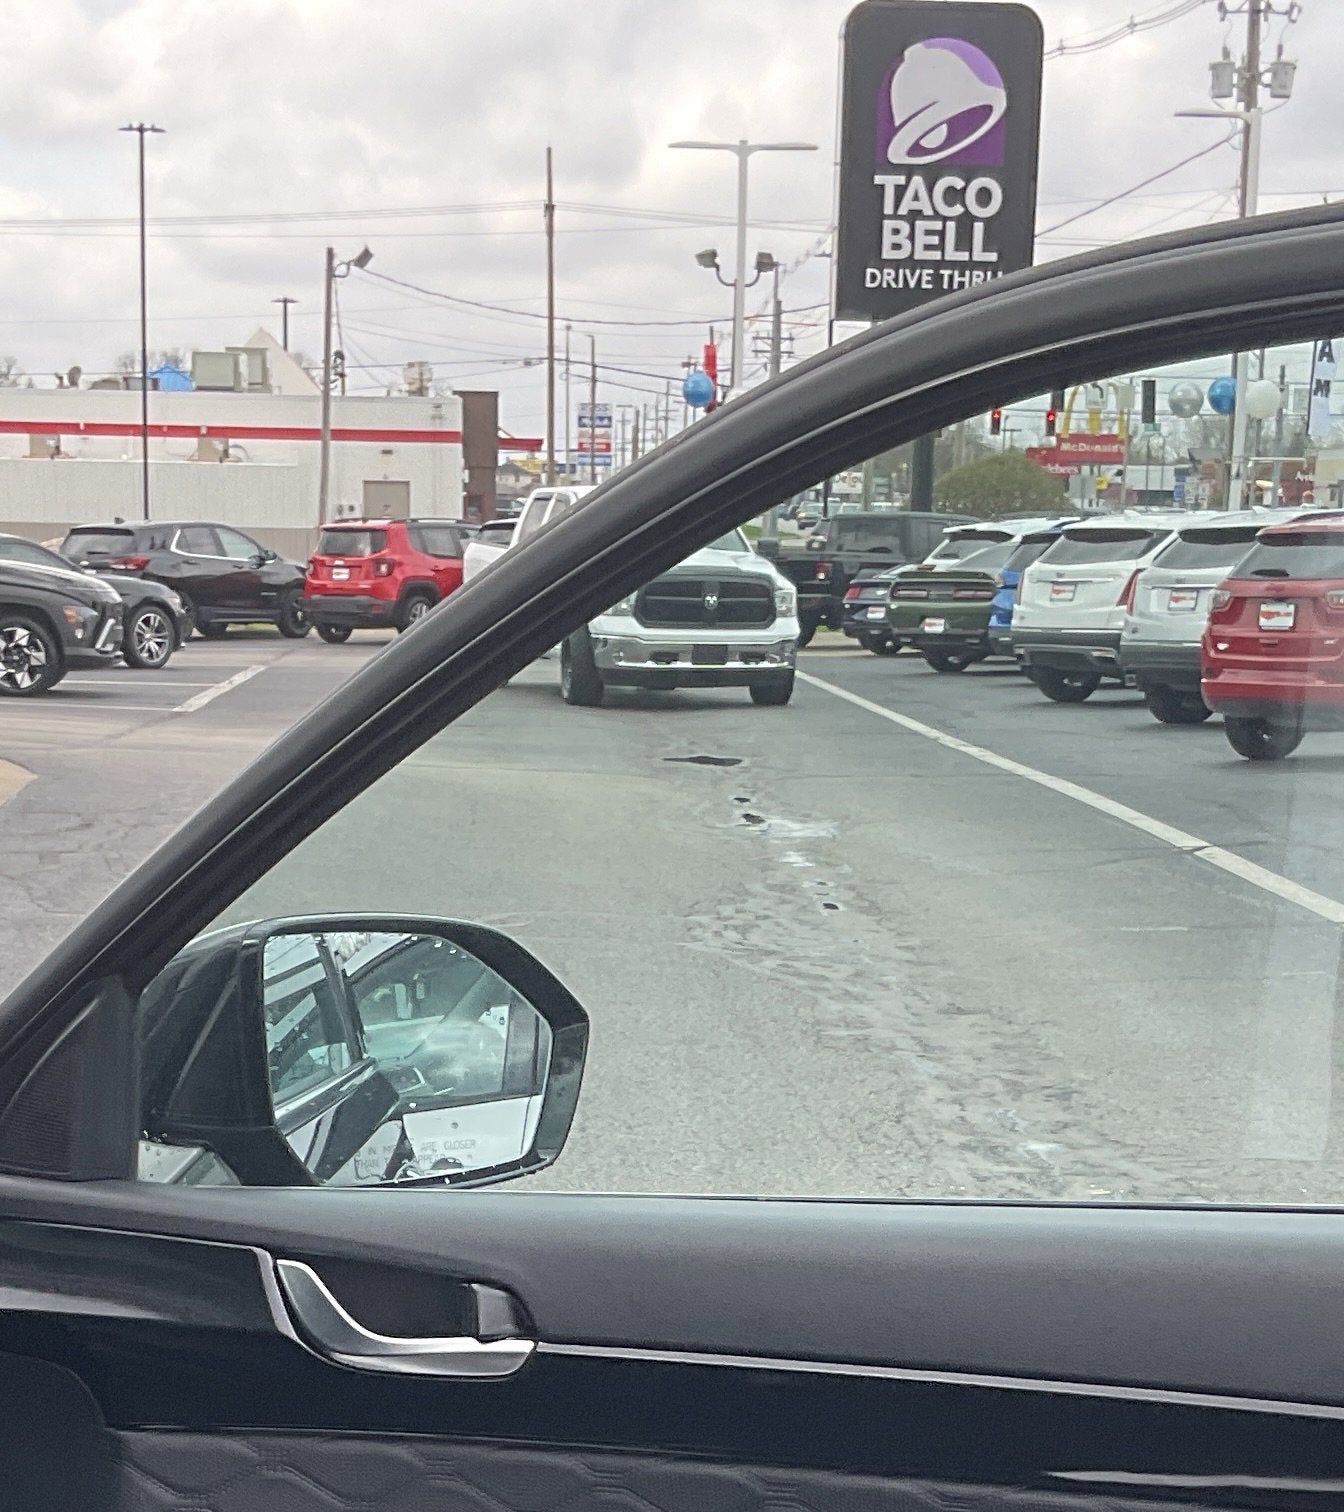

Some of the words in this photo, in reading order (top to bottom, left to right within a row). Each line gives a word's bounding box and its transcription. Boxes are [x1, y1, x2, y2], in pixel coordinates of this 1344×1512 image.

[874, 175, 1003, 218] TACO
[881, 219, 998, 262] BELL
[864, 267, 934, 289] DRIVE
[444, 1139, 476, 1150] CLOSER
